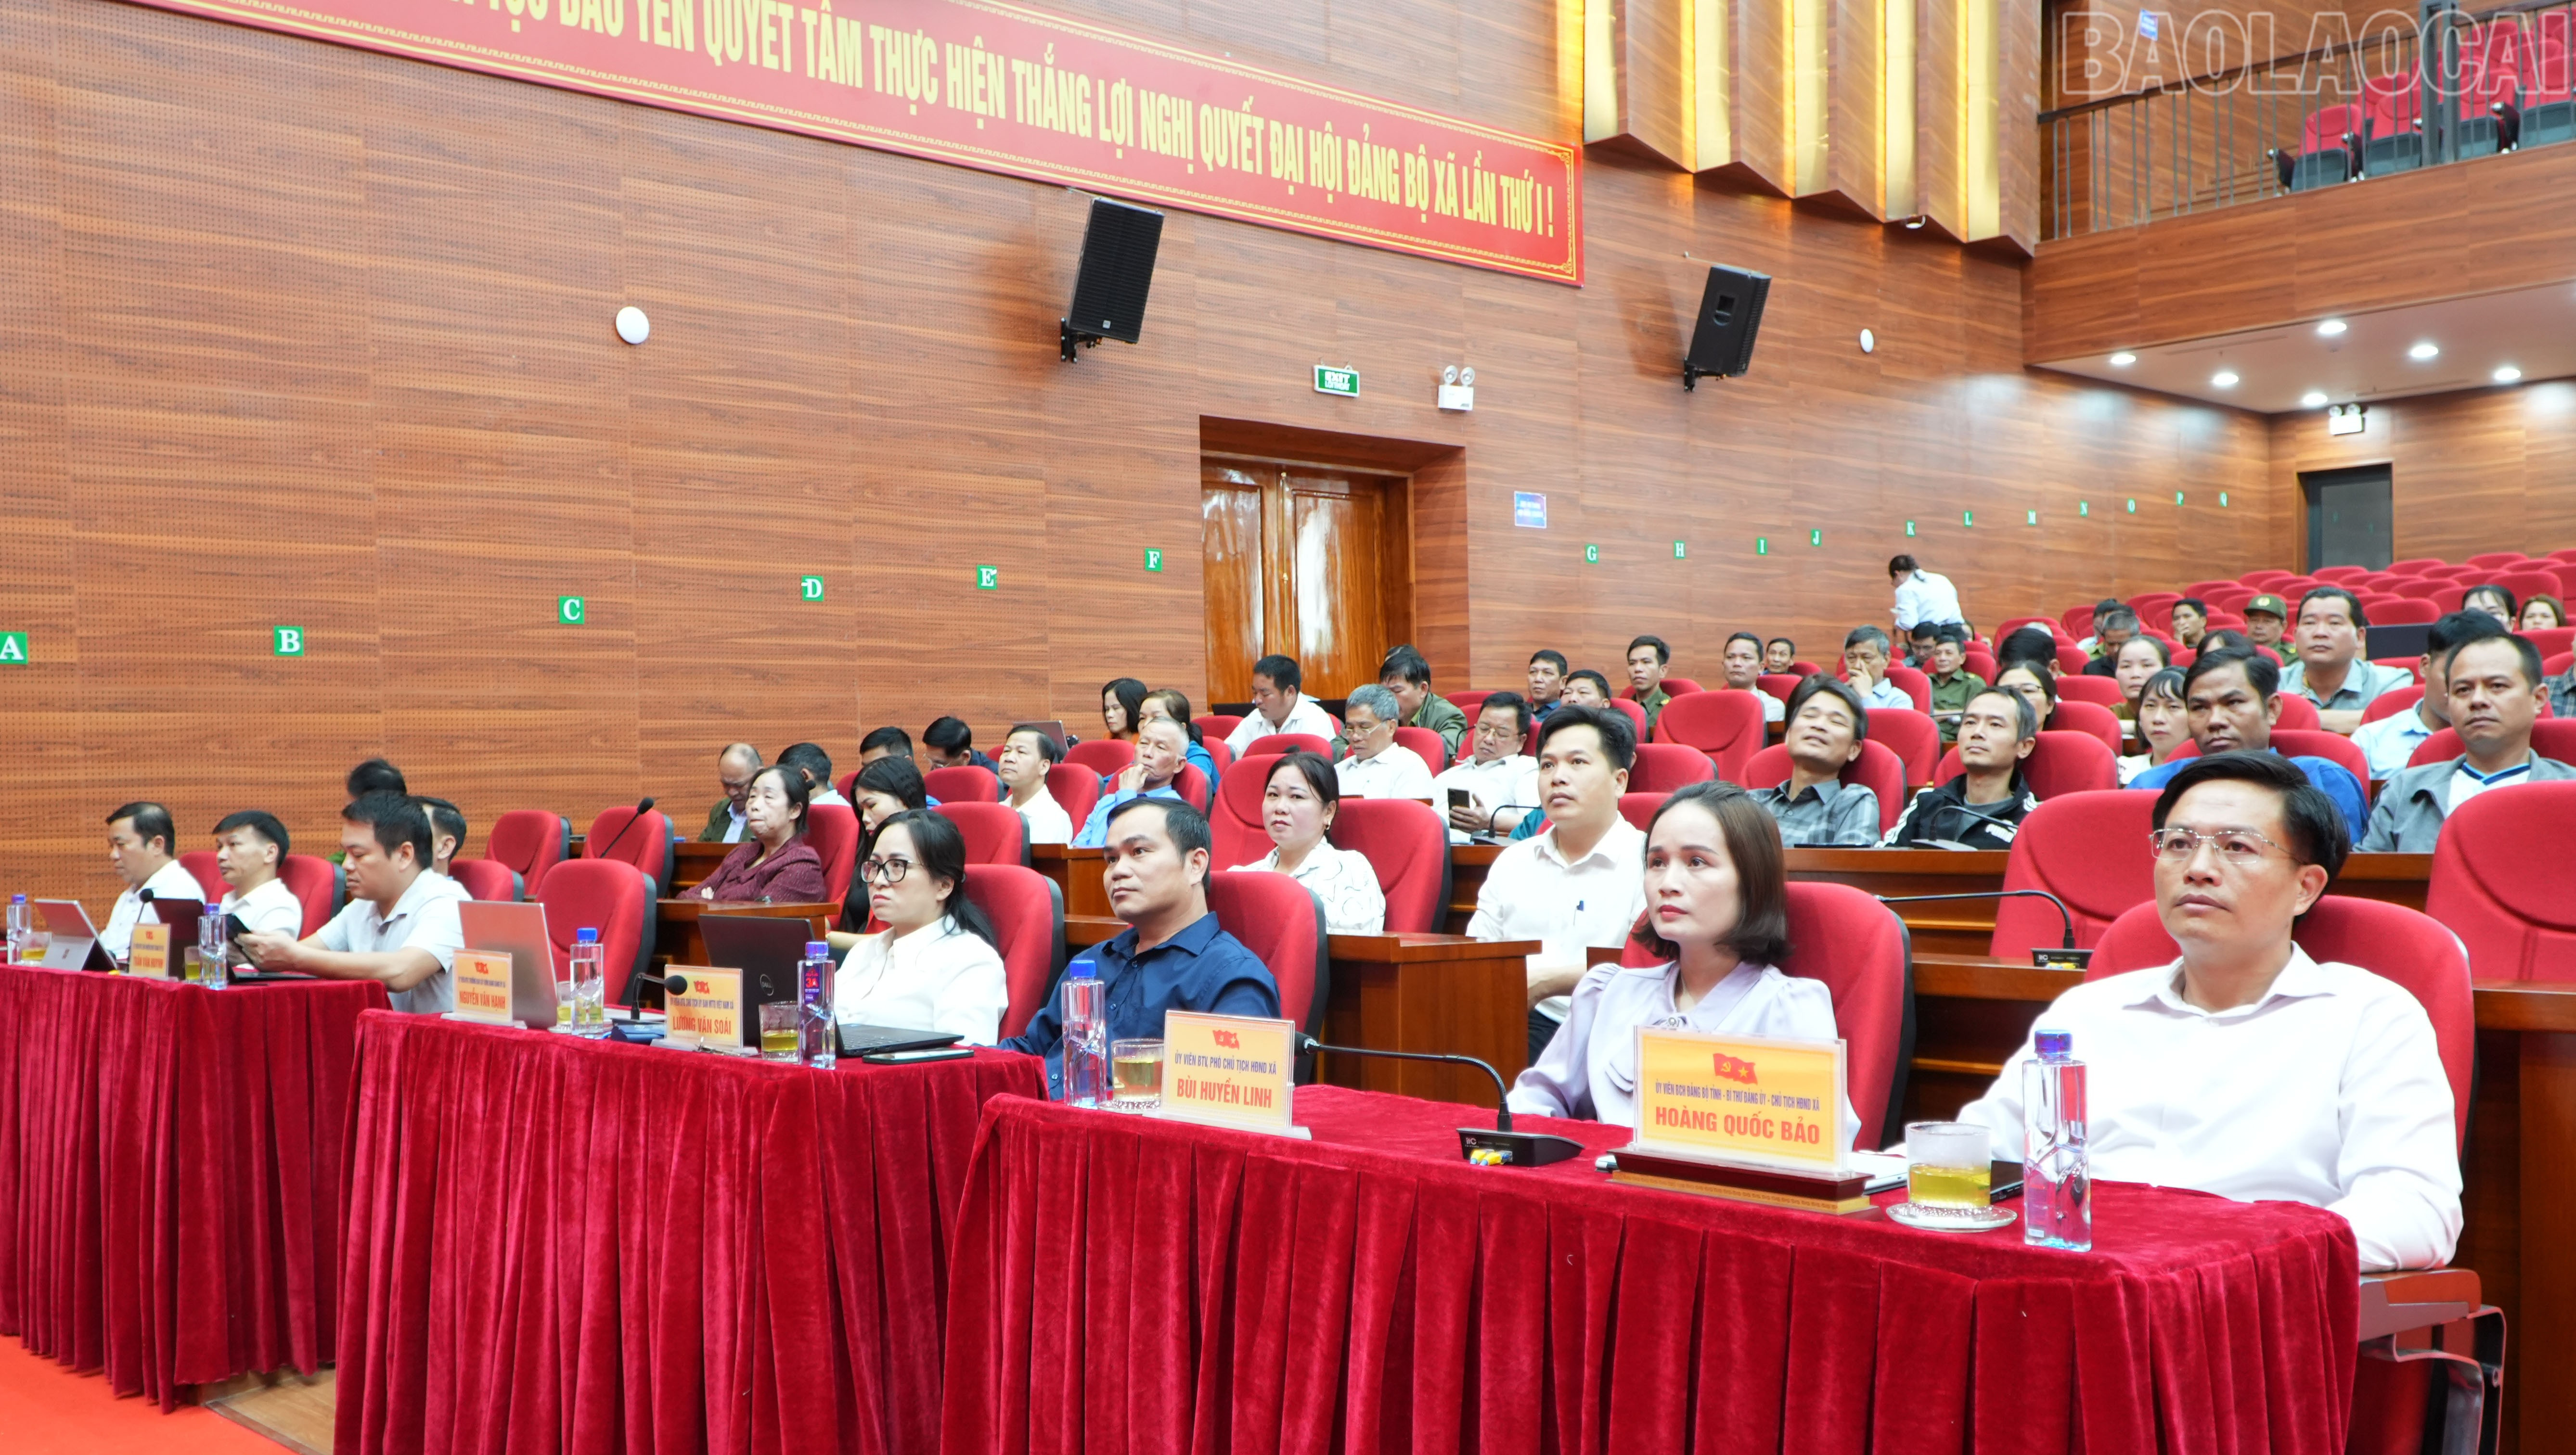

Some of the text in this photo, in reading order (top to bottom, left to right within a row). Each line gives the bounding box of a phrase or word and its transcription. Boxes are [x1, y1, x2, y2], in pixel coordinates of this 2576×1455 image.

[800, 0, 863, 88] TÂM
[869, 24, 939, 116] THỰC
[945, 35, 1007, 129] HIỆN
[1011, 42, 1093, 139] THẮNG
[1097, 77, 1135, 159] LỢI
[1139, 88, 1195, 175] NGHỊ
[1198, 94, 1267, 175] QUYẾT
[1268, 119, 1305, 195] ĐẠI
[1309, 120, 1344, 204] HỘI
[1346, 123, 1401, 204] ĐẢNG
[1404, 143, 1430, 223] BỘ
[1433, 151, 1459, 217] XÃ
[1462, 150, 1497, 225] LẦN
[1499, 168, 1535, 233] THỨ
[1325, 371, 1350, 383] EXIT
[2177, 492, 2184, 504] P
[2080, 502, 2088, 515] N
[1965, 512, 1972, 525] L
[1907, 522, 1915, 535] K
[1760, 539, 1765, 553] I
[1813, 531, 1819, 545] J
[1587, 546, 1597, 561] G
[1675, 542, 1685, 557] H
[1149, 551, 1160, 568] F
[981, 568, 995, 587] E
[806, 578, 822, 598] D
[564, 599, 580, 620] C
[0, 635, 24, 660] A
[279, 629, 300, 653] B
[480, 991, 490, 1008] VĂN
[491, 995, 505, 1012] HẠNH
[698, 1016, 712, 1033] VĂN
[714, 1017, 731, 1034] SOÁI
[1175, 1049, 1182, 1064] ỦY
[1184, 1052, 1196, 1066] VIÊN
[1210, 1055, 1221, 1069] PHÓ
[1223, 1055, 1235, 1071] CHỦ
[1236, 1059, 1249, 1073] TỊCH
[1251, 1060, 1267, 1073] HĐND
[1268, 1061, 1276, 1075] XÃ
[1177, 1075, 1272, 1109] BÙI HUYỀN LINH
[1656, 1079, 1662, 1094] ỦY
[1663, 1082, 1674, 1096] VIÊN
[1676, 1085, 1686, 1097] BCH
[1687, 1082, 1701, 1098] ĐẢNG
[1702, 1085, 1709, 1102] BỘ
[1710, 1085, 1722, 1100] TỈNH
[1726, 1087, 1732, 1101] BÍ
[1733, 1090, 1743, 1103] THƯ
[1744, 1088, 1758, 1105] ĐẢNG
[1759, 1089, 1766, 1105] ỦY
[1771, 1091, 1782, 1107] CHỦ
[1783, 1096, 1795, 1110] TỊCH
[1796, 1097, 1811, 1110] HĐND
[1813, 1097, 1820, 1111] XÃ
[1656, 1105, 1820, 1145] HOÀNG QUỐC BẢO
